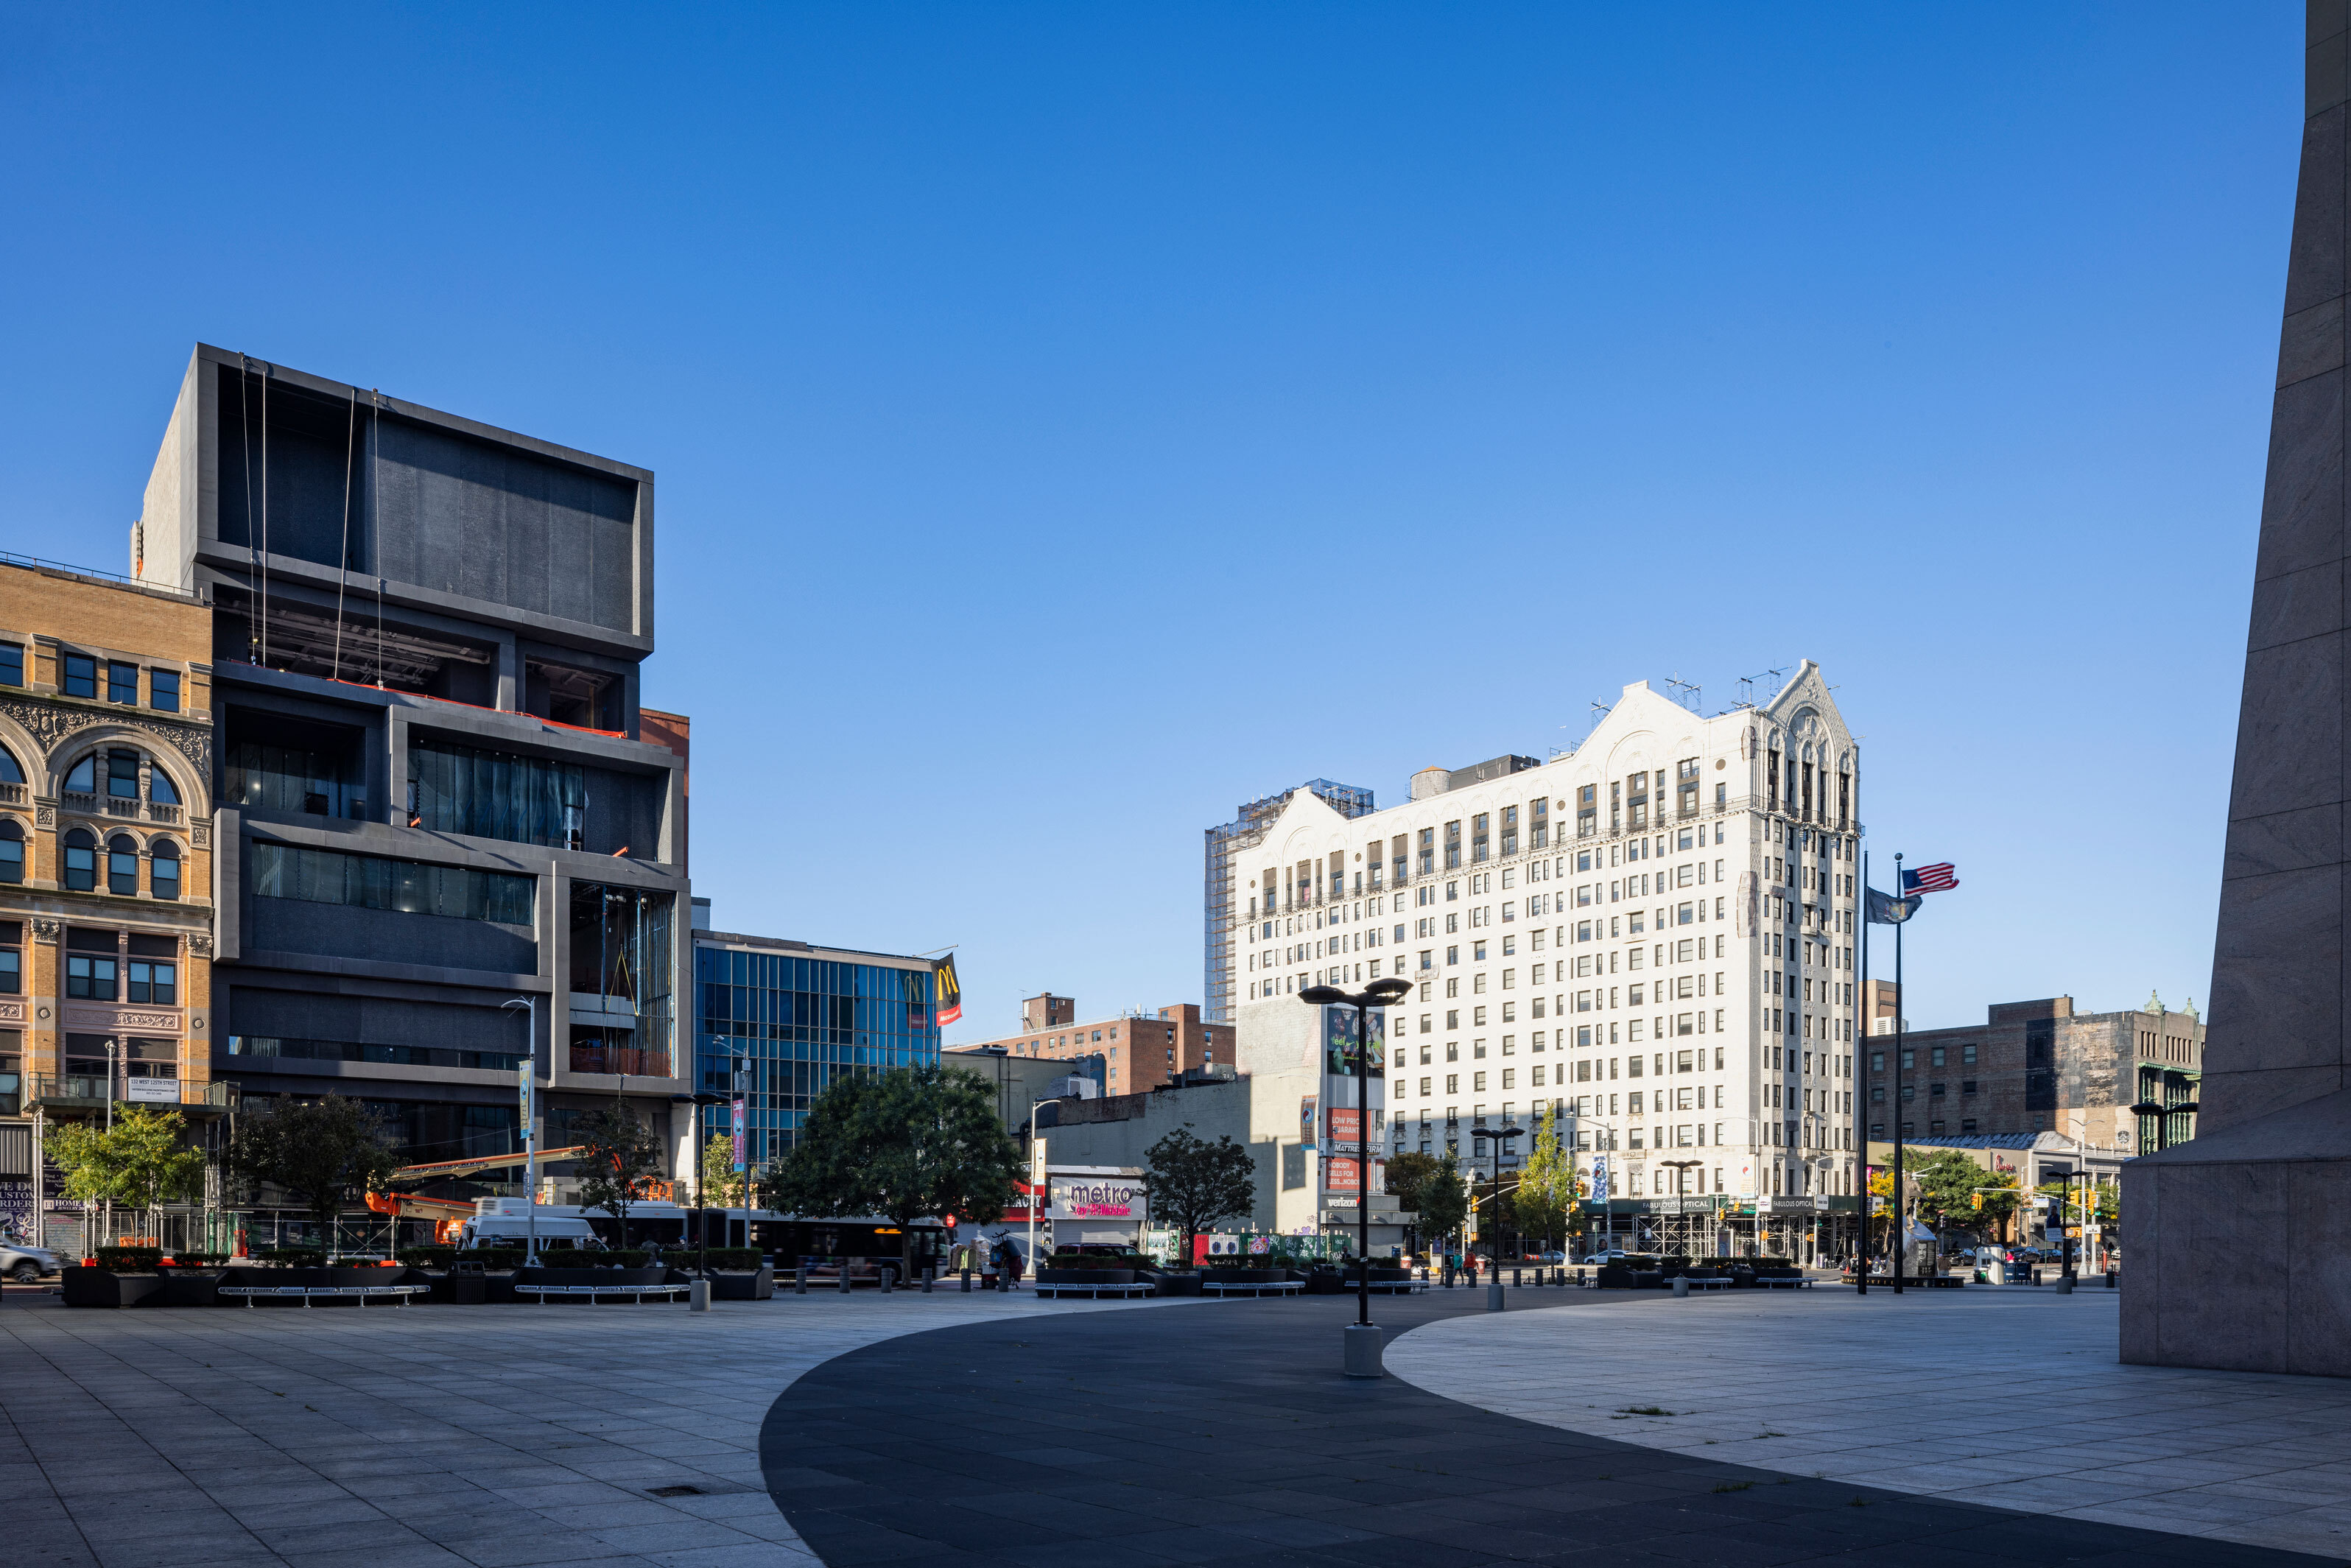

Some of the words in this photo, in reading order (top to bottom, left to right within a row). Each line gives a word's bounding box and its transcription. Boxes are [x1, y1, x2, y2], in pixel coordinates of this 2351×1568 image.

[1331, 1036, 1345, 1046] feel
[1332, 1125, 1360, 1134] UARANT
[1366, 1145, 1383, 1153] FIRM
[1069, 1182, 1132, 1203] metro
[0, 1200, 38, 1208] RDERS
[1327, 1198, 1357, 1208] verizon
[1089, 1203, 1132, 1216] T-Mobile
